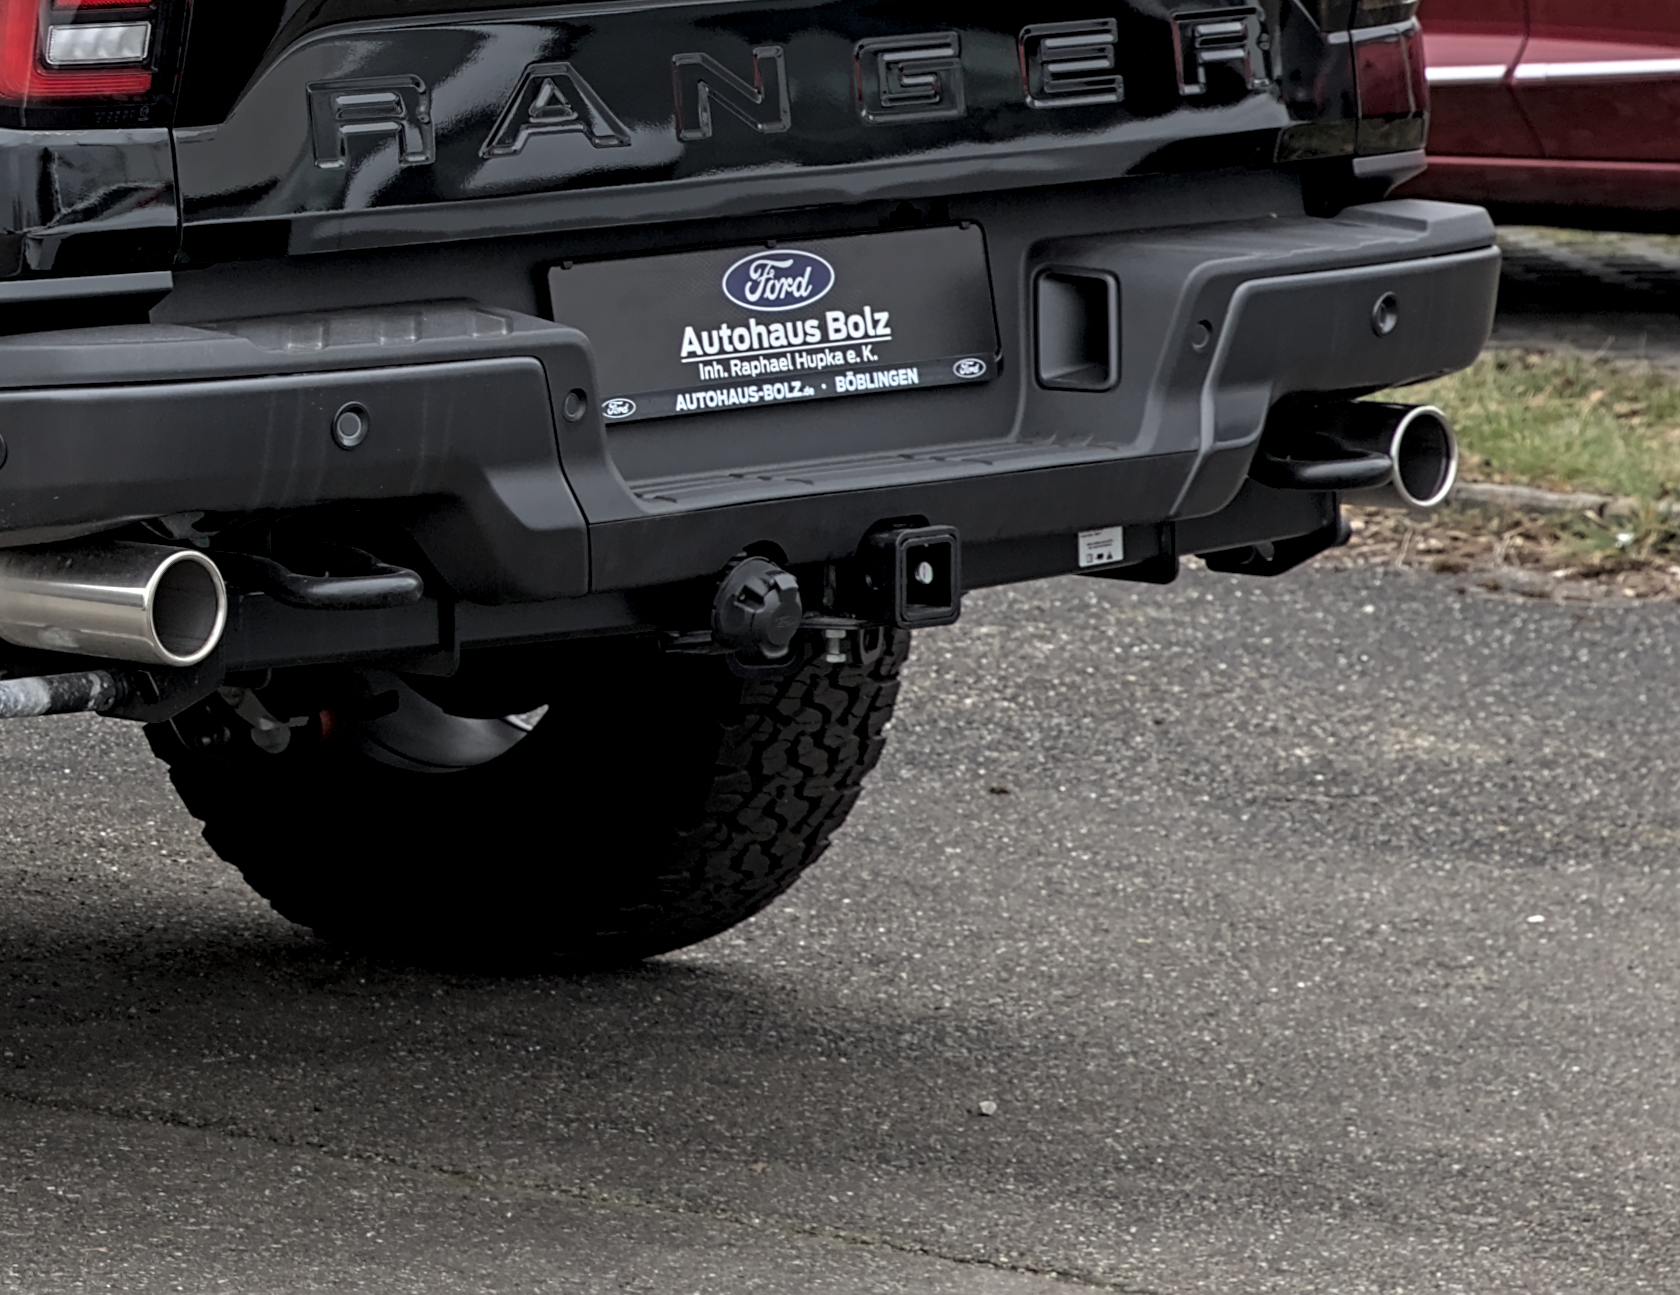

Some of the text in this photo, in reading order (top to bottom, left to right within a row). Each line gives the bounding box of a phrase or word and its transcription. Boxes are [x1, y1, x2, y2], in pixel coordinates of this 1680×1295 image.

[305, 6, 1274, 171] RANGER
[745, 258, 813, 302] Ford
[680, 304, 892, 359] Autohaus Bolz
[698, 344, 879, 381] Inh. Raphael Hupka e. K.
[606, 400, 630, 415] Ford
[675, 367, 919, 412] AUTOHAUS-BOLZ.de BÖBLINGEN
